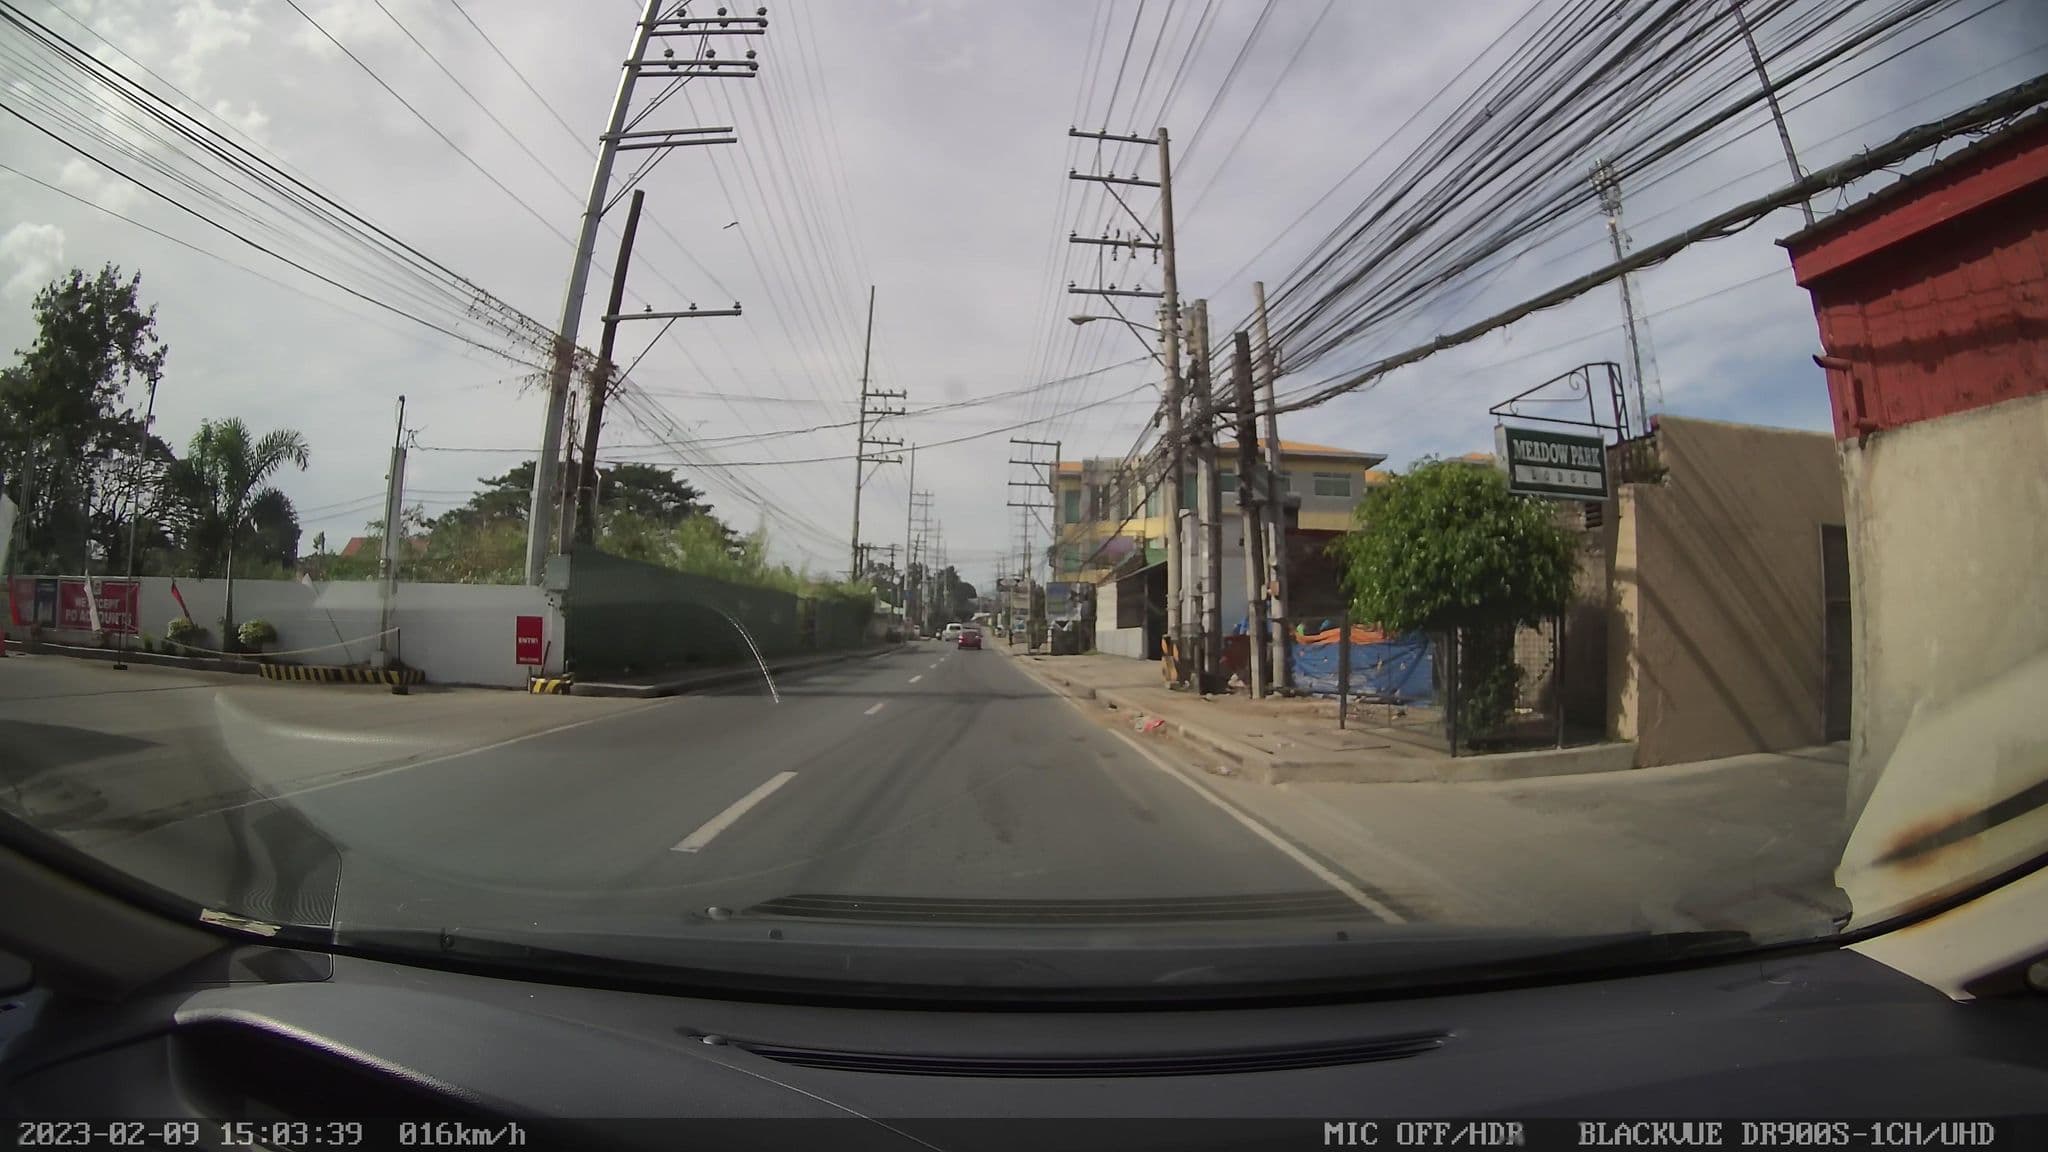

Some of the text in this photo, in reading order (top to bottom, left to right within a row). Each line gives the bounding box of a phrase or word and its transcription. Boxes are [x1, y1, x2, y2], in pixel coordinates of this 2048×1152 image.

[1512, 439, 1601, 467] MEADOW PARK
[80, 610, 132, 625] ACOUNTS
